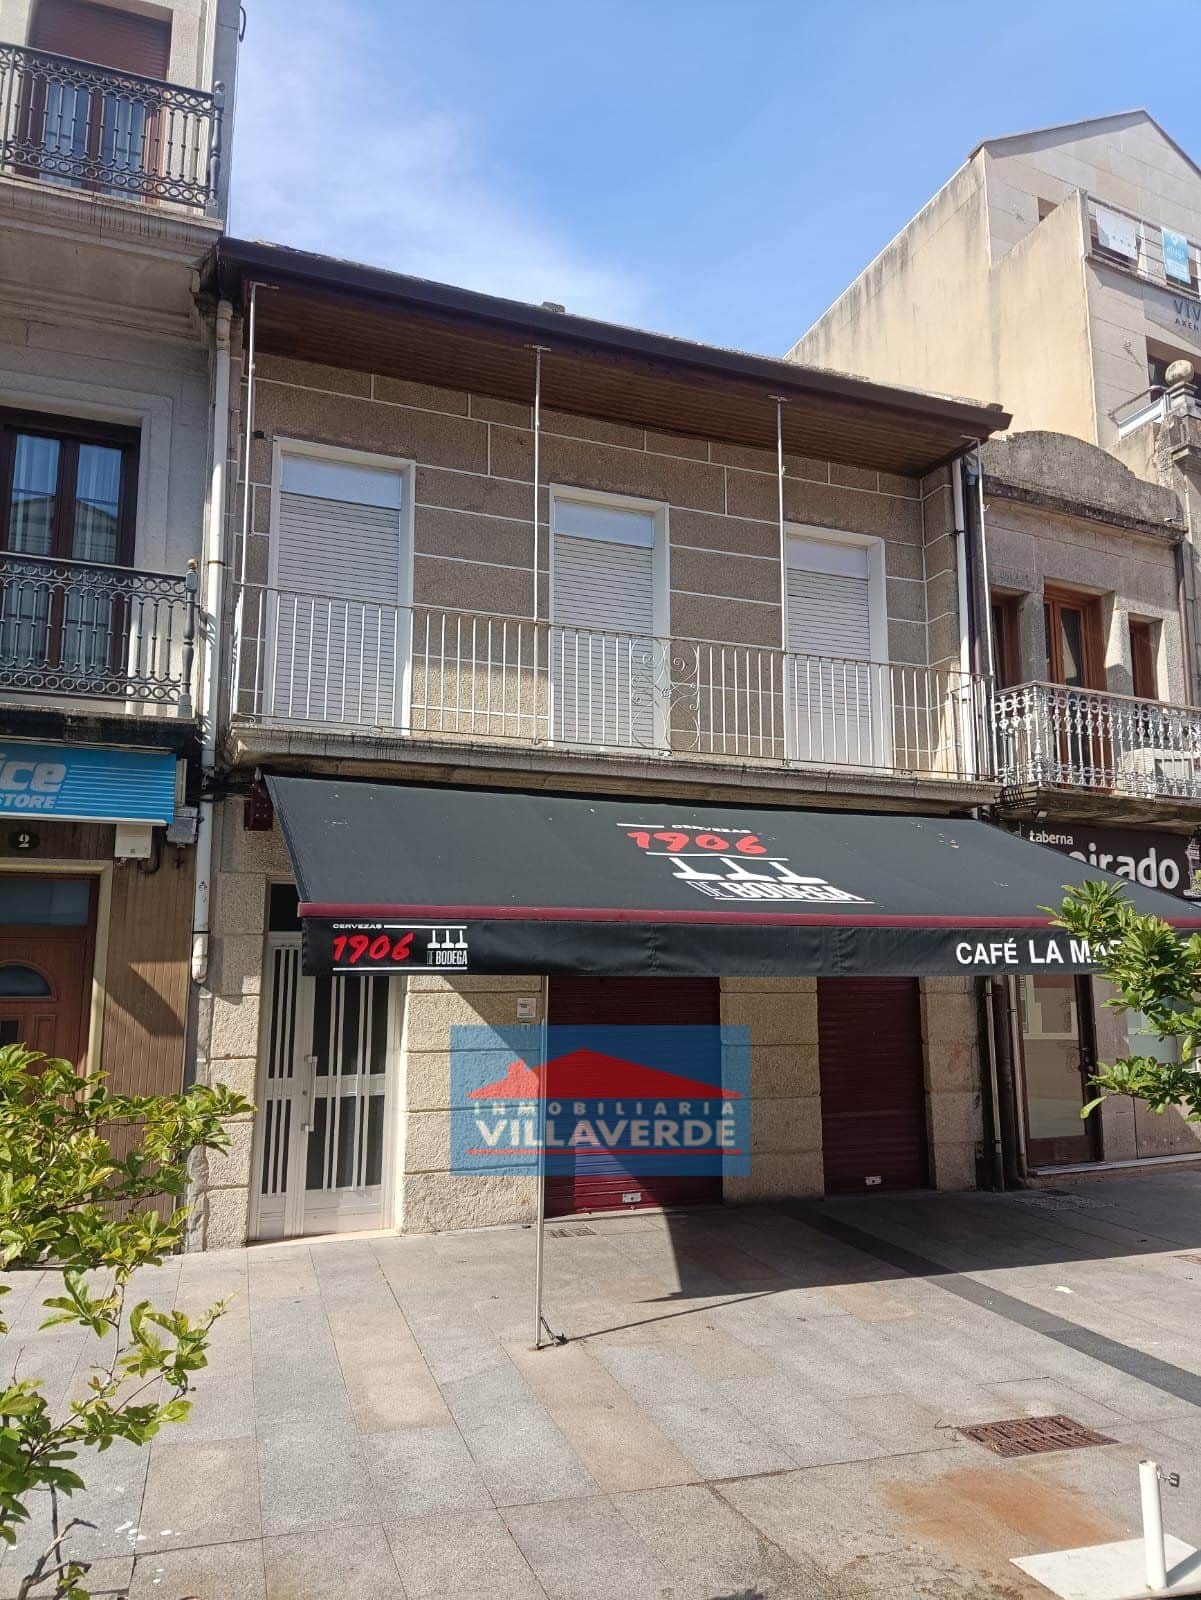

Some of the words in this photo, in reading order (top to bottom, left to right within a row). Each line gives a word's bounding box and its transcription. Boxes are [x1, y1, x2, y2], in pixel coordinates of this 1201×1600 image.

[17, 833, 32, 848] 2
[626, 831, 768, 855] 1906
[1029, 830, 1074, 846] taberna
[717, 882, 866, 901] BODEGA
[332, 931, 415, 965] 1906
[435, 950, 468, 965] BODEGA
[955, 937, 1019, 965] CAFÉ
[1028, 939, 1065, 965] LA
